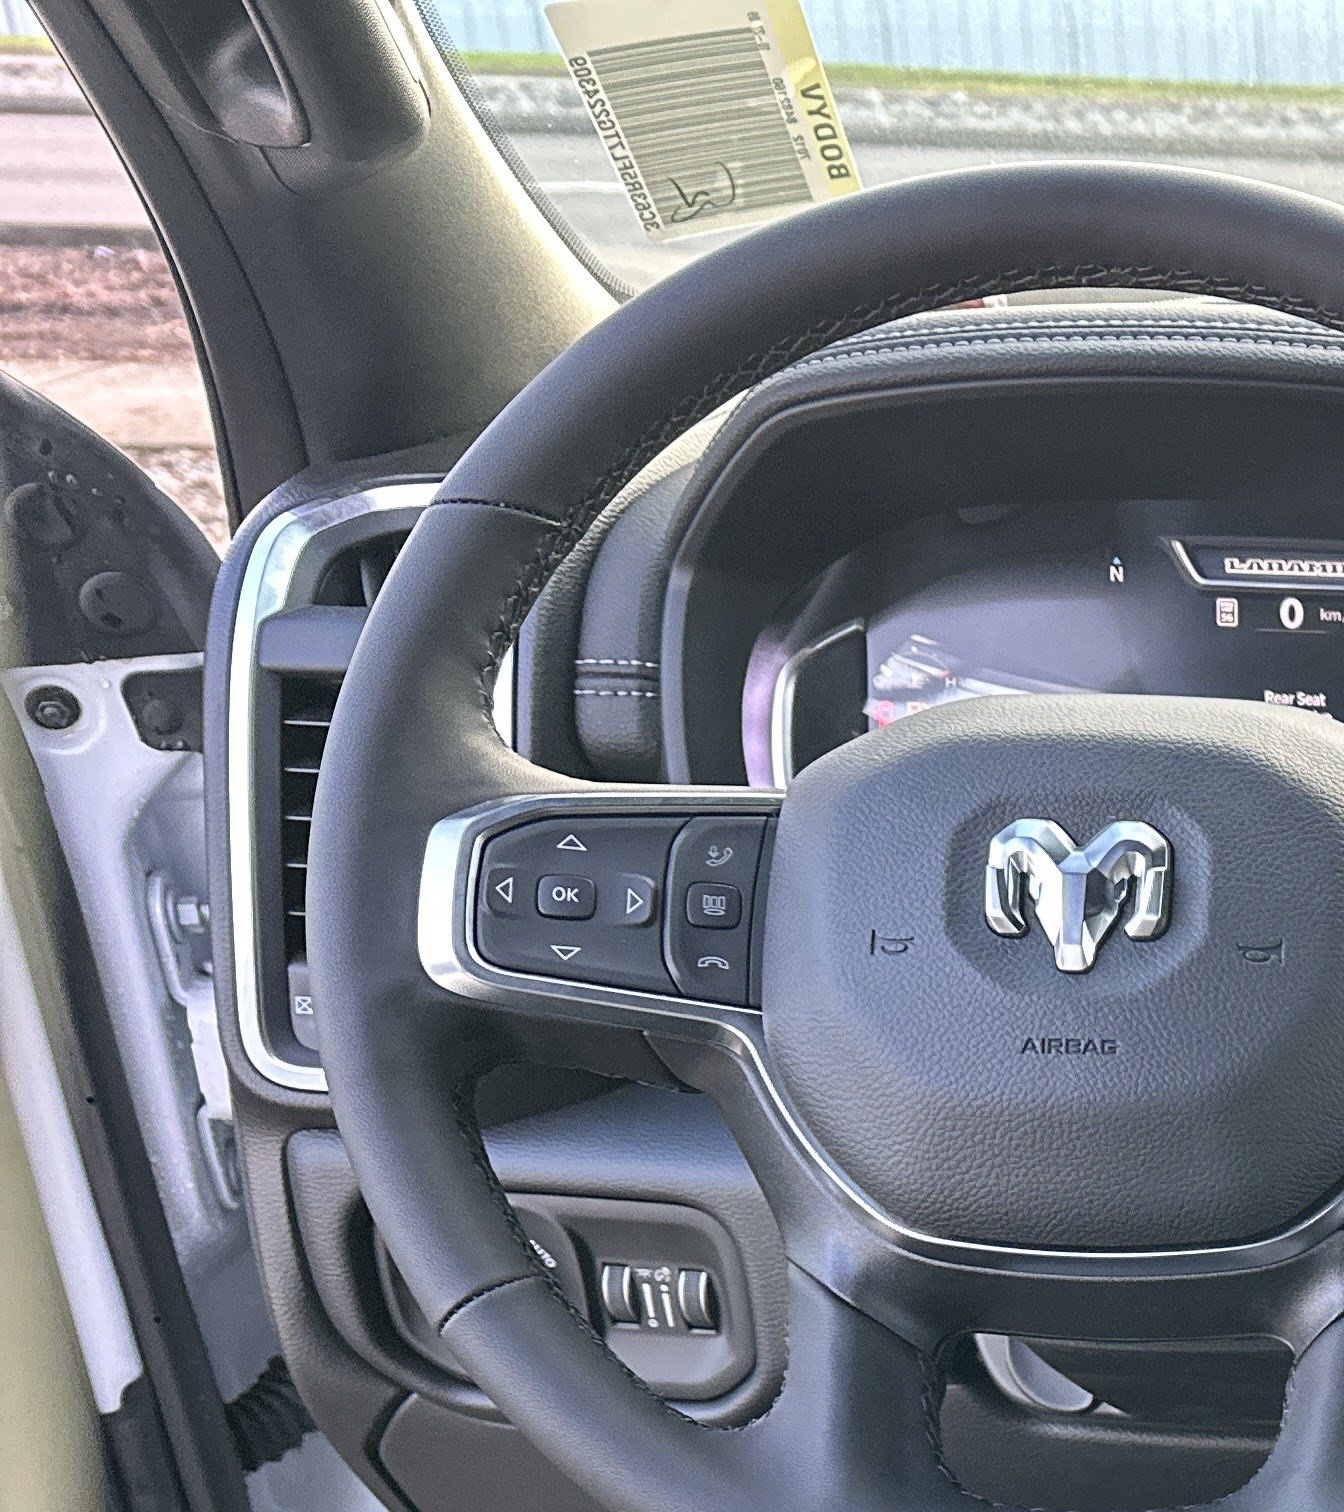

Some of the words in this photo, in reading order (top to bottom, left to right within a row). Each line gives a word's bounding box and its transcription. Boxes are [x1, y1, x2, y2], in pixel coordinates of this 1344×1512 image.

[1109, 565, 1124, 583] N
[1279, 597, 1304, 629] 0
[1263, 689, 1295, 705] Rear
[1296, 690, 1326, 708] Seat
[552, 886, 580, 903] OK
[1020, 1037, 1118, 1056] AIRBAG
